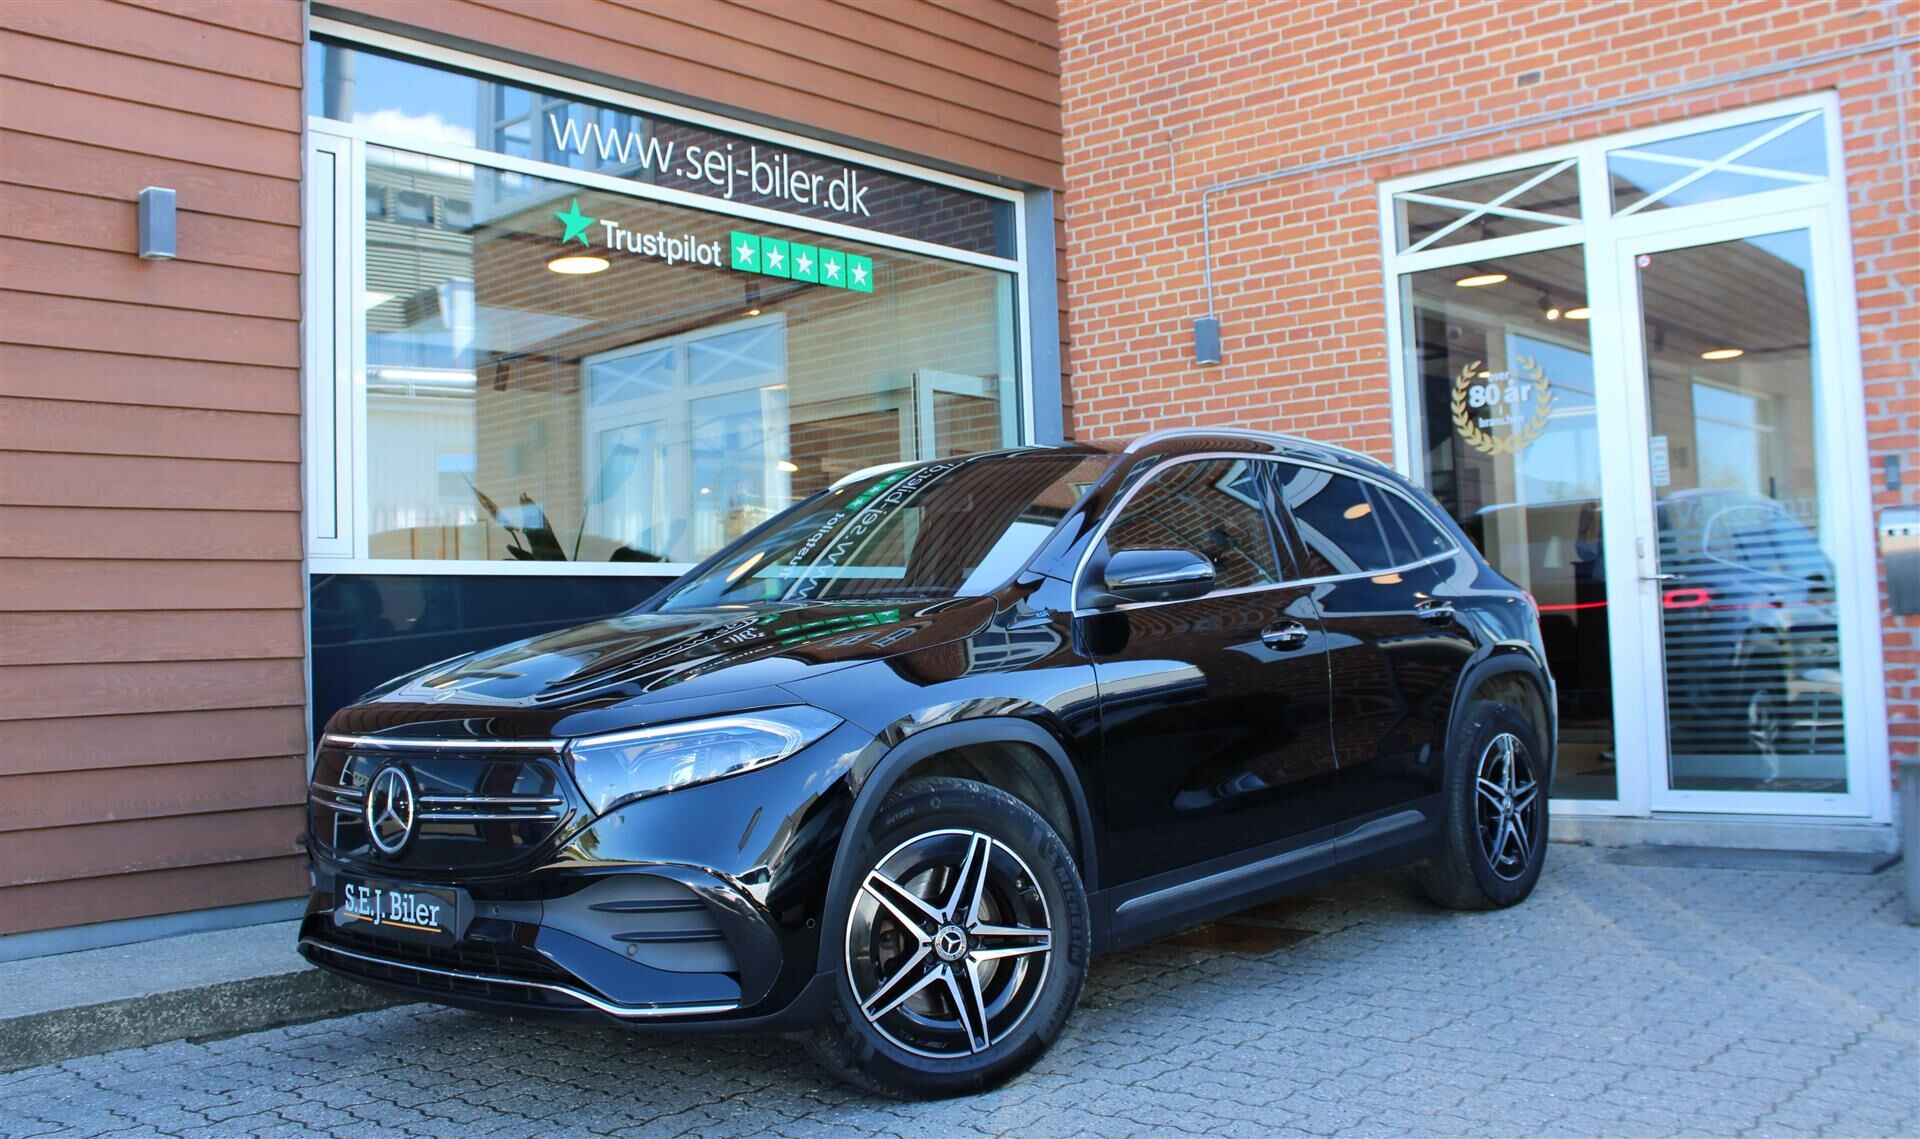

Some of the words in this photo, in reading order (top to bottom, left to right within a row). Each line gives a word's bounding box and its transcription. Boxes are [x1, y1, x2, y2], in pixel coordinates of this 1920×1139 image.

[549, 112, 871, 217] www.sej-biler.dk
[600, 219, 722, 266] Trustpilot
[1469, 384, 1501, 408] 80
[1504, 378, 1531, 404] år
[344, 884, 386, 926] S.E.J.
[390, 892, 440, 926] Biler
